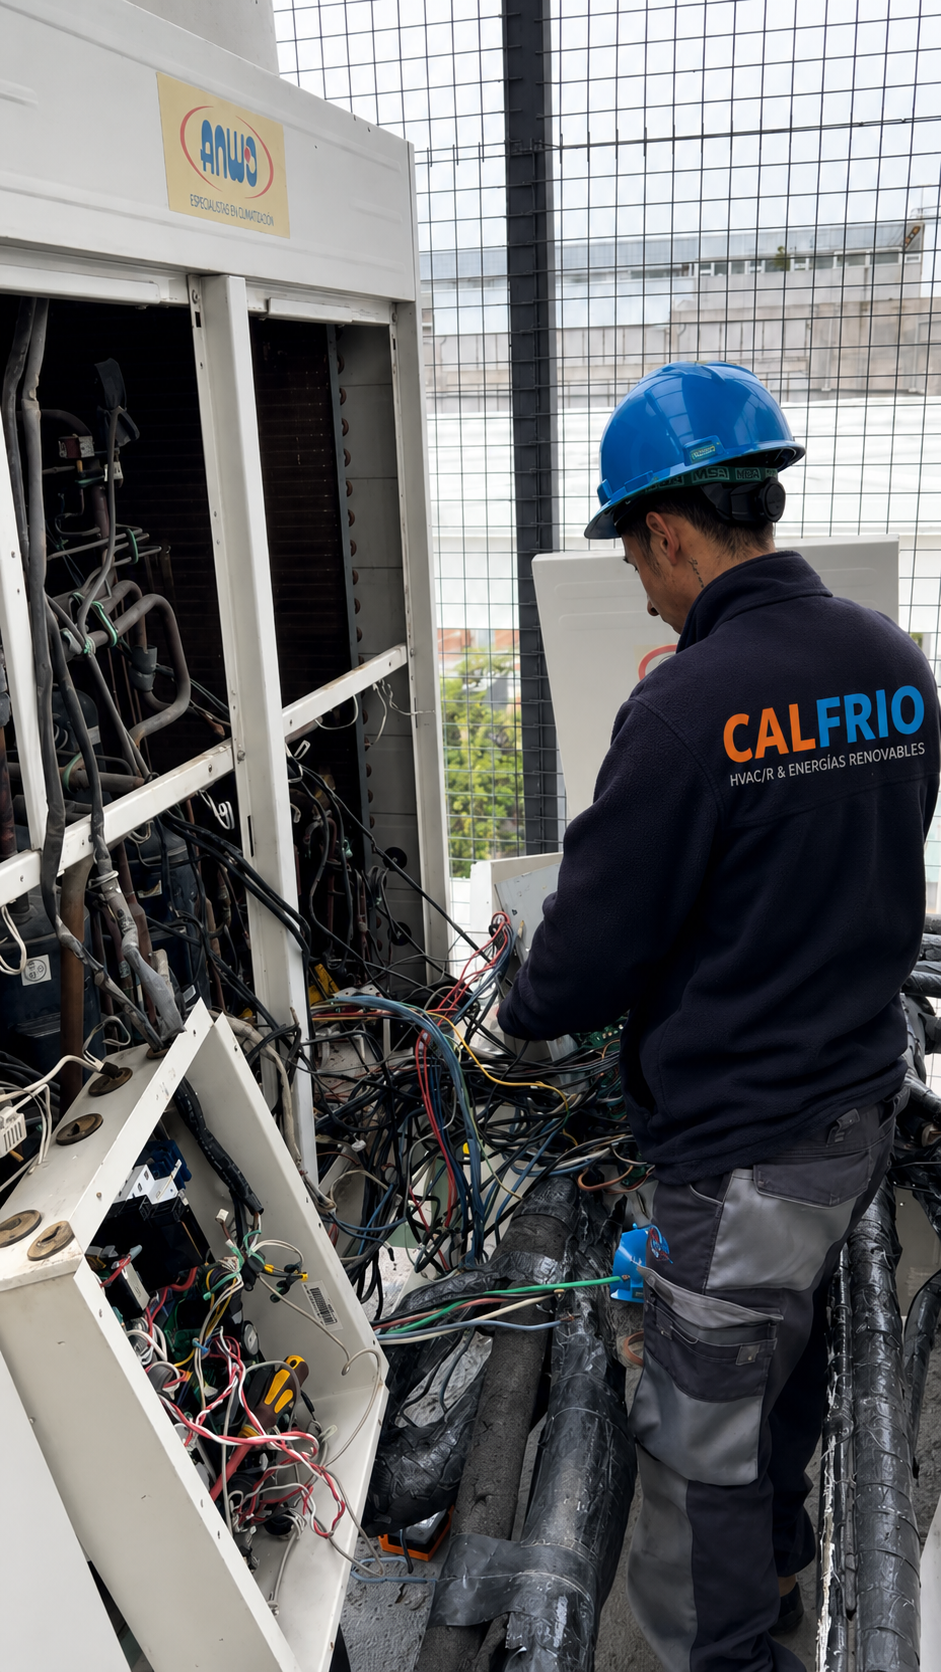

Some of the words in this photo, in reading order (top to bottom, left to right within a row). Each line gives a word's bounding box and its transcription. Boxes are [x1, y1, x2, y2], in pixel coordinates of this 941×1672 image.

[190, 193, 230, 215] ESPECIALISTAS
[230, 204, 238, 218] EN
[693, 467, 728, 481] MSA
[723, 685, 925, 763] CALFRIO
[729, 767, 775, 787] HVAC/R
[777, 765, 786, 779] &
[788, 753, 846, 777] ENERGÍAS
[849, 742, 926, 767] RENOVABLES
